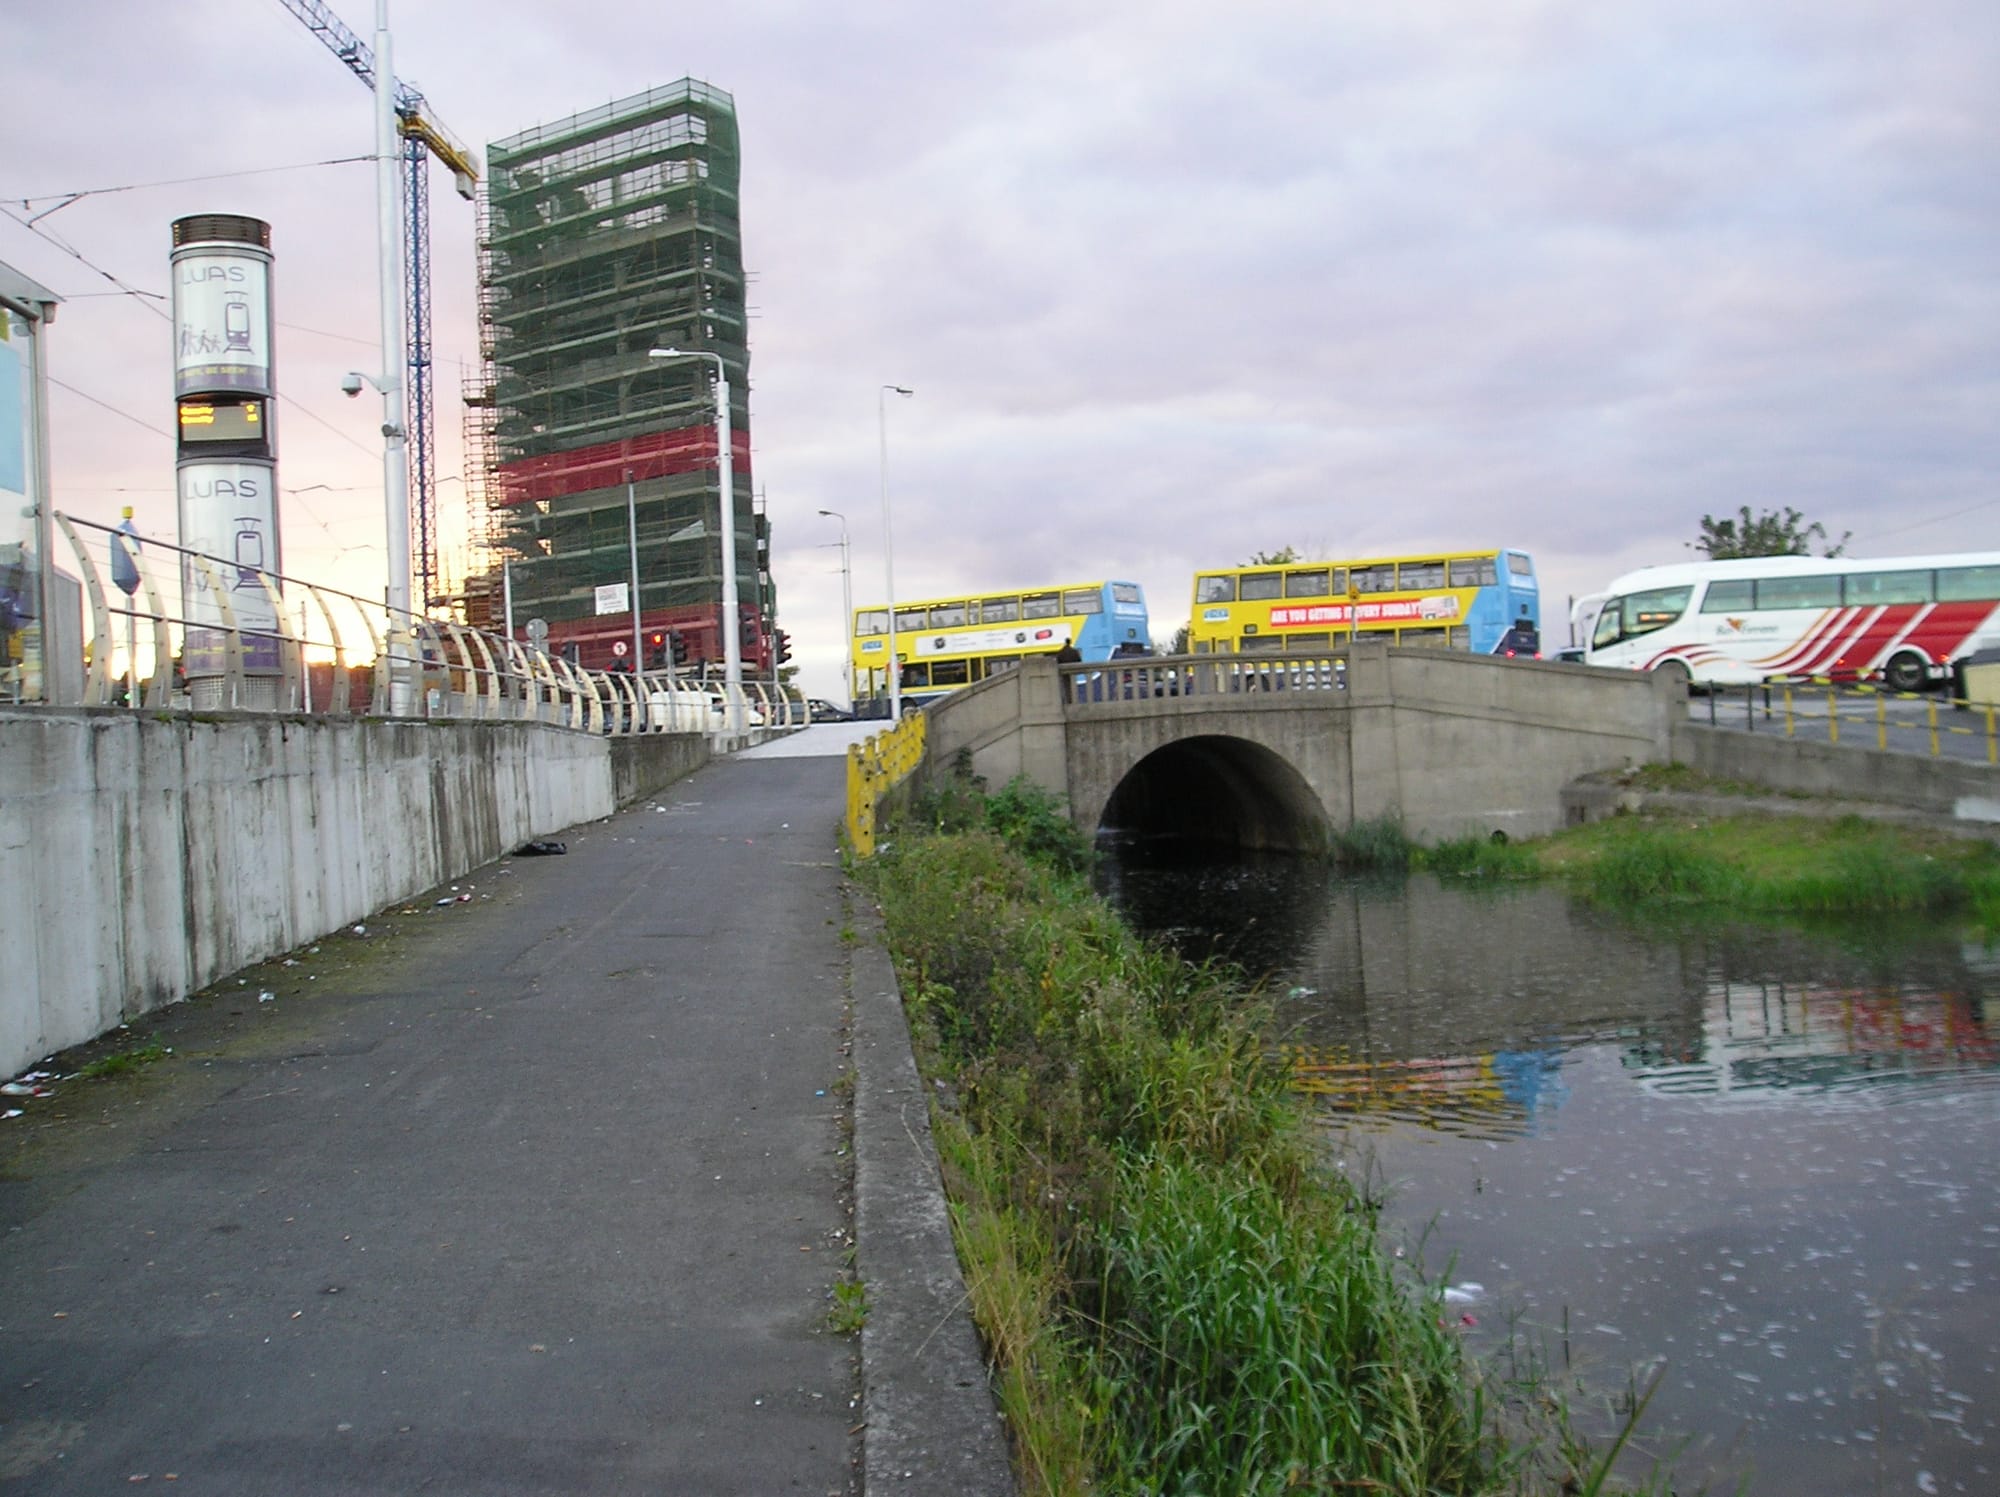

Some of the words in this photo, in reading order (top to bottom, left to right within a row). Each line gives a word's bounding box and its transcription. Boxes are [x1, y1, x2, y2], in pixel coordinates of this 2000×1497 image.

[181, 265, 246, 285] LUAS
[184, 479, 258, 500] LUAS
[1289, 608, 1307, 623] YOU
